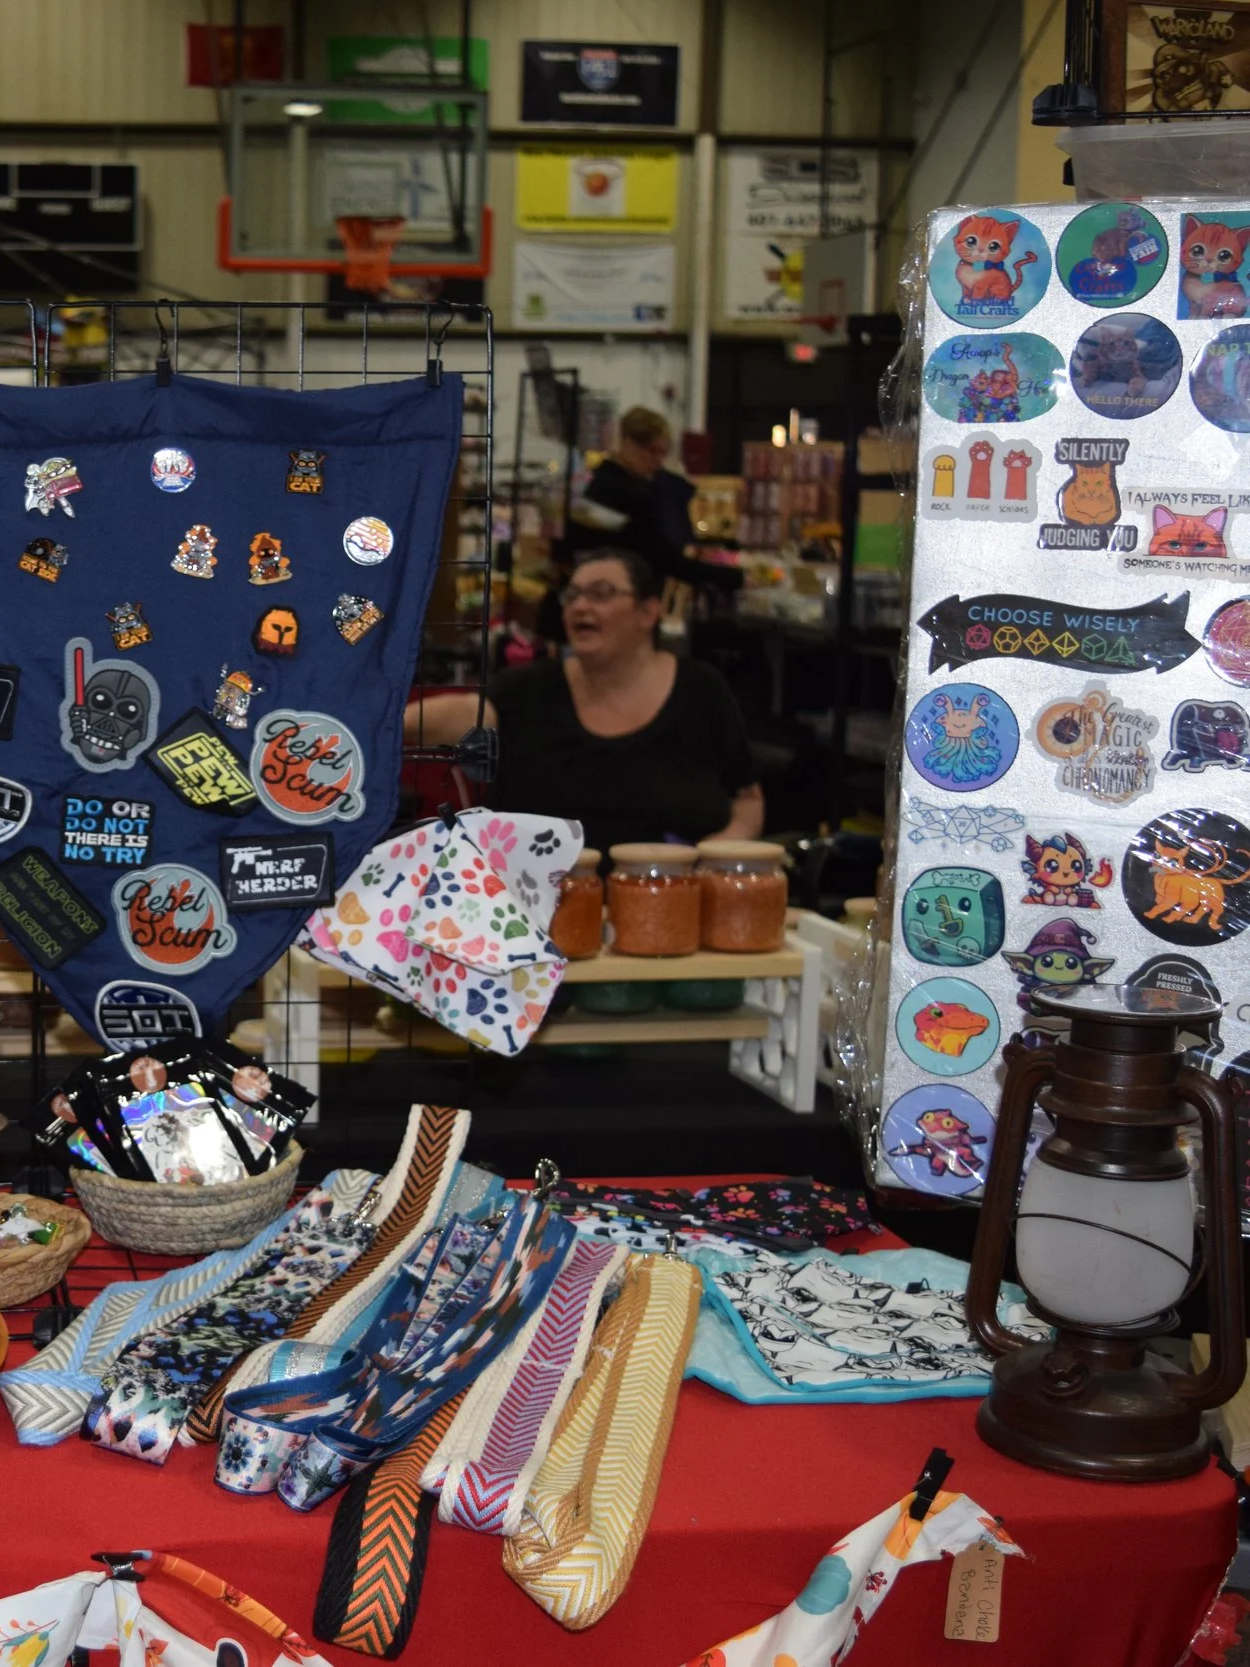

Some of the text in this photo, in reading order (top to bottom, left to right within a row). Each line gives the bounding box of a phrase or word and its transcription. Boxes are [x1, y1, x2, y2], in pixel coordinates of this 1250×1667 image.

[1086, 393, 1159, 407] HELLO THERE
[1059, 442, 1126, 462] SILENTLY
[930, 503, 952, 511] ROCK
[1134, 492, 1188, 508] ALWAYS
[1191, 493, 1225, 506] FEEL
[1043, 528, 1100, 547] JUDGING
[1123, 557, 1182, 571] SOMEONE'S
[1184, 562, 1238, 576] WATCHING
[967, 606, 1141, 634] CHOOSE WISELY
[1102, 702, 1155, 734] Greatest
[262, 718, 353, 770] Rebel
[1083, 723, 1143, 748] MAGIC
[167, 746, 224, 802] PEW
[183, 739, 247, 796] PEW
[259, 749, 356, 813] Scum
[1062, 765, 1152, 794] CHRONOMANCY
[66, 798, 151, 819] DO OR
[65, 816, 149, 834] DO NOT
[64, 831, 149, 848] THERE IS
[64, 843, 147, 864] NO TRY
[254, 857, 306, 876] NERF
[22, 855, 99, 934] WEAPONS
[234, 874, 319, 895] HERDER
[120, 879, 207, 913] Rebel
[131, 911, 228, 950] Scum
[1155, 980, 1193, 992] PRESSED
[1157, 972, 1194, 985] FRESHLY
[974, 1559, 999, 1640] Anti Choke
